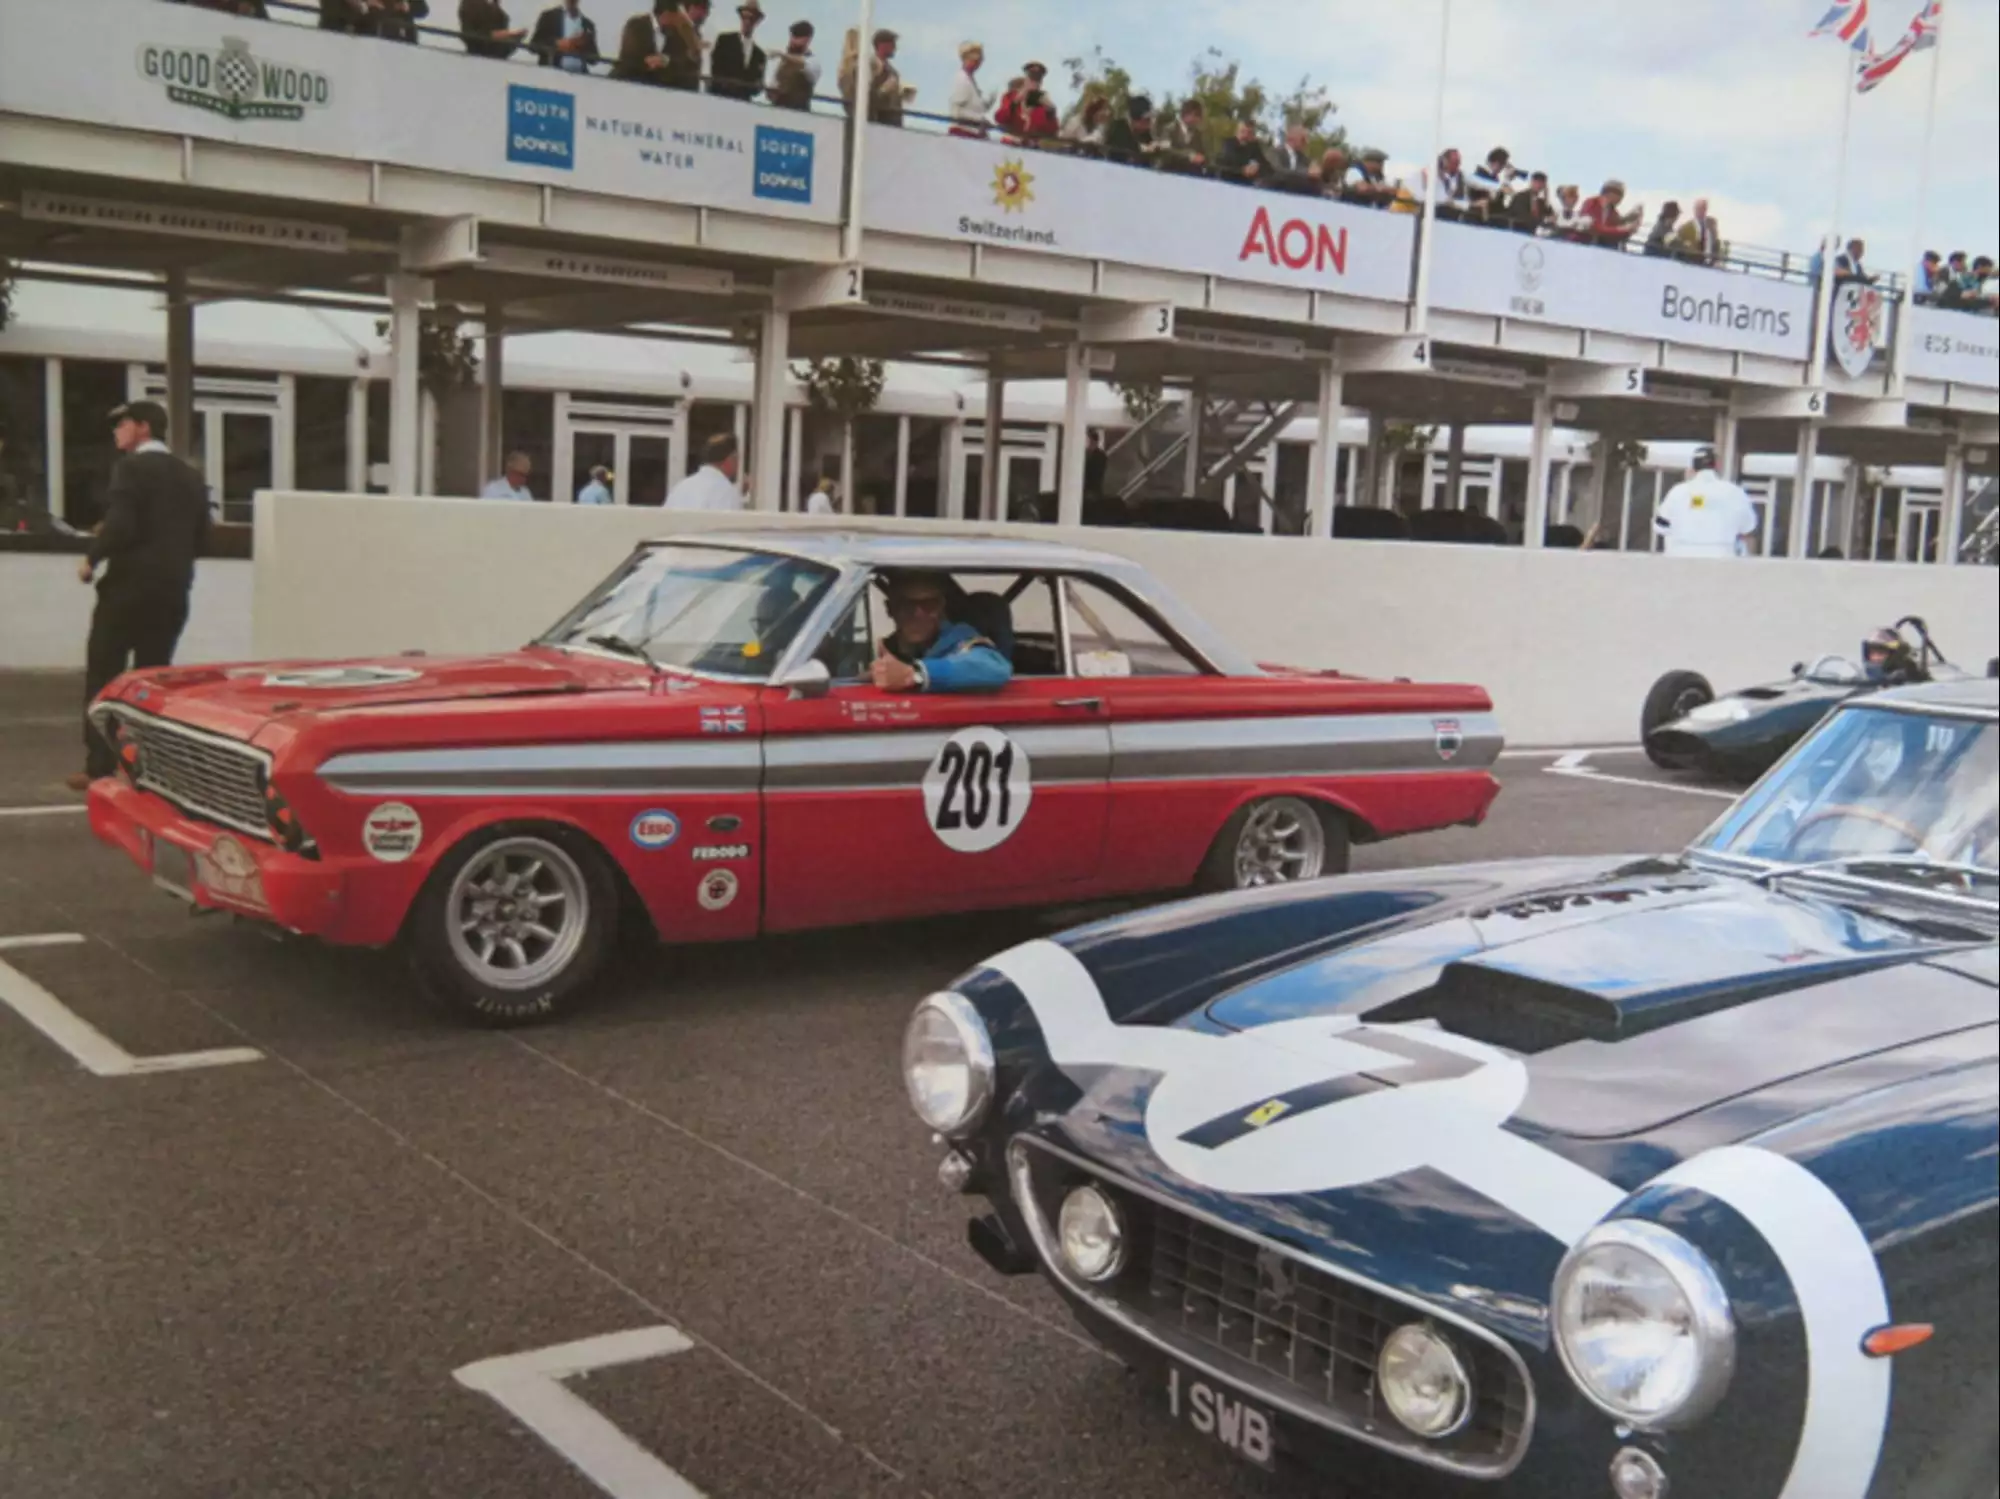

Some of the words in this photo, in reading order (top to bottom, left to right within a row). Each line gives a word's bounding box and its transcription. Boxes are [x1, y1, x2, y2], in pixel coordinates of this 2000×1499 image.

[144, 47, 210, 89] GOOD
[262, 63, 328, 103] WOOD
[514, 99, 570, 121] SOUTH
[513, 135, 568, 156] DOWNS
[585, 115, 664, 142] NATURAL
[672, 129, 744, 154] MINERAL
[639, 148, 694, 169] WATER
[759, 138, 809, 158] SOUTH
[759, 171, 806, 191] DOWNS
[1238, 205, 1348, 275] AON
[847, 268, 858, 297] 2
[1157, 308, 1169, 334] 3
[1661, 284, 1790, 336] Bonhams
[1413, 340, 1426, 363] 4
[1626, 368, 1638, 391] 5
[1808, 392, 1821, 412] 6
[935, 740, 1014, 831] 201
[637, 821, 674, 837] Esso
[1166, 1367, 1180, 1418] 1
[1190, 1381, 1270, 1463] SWB
